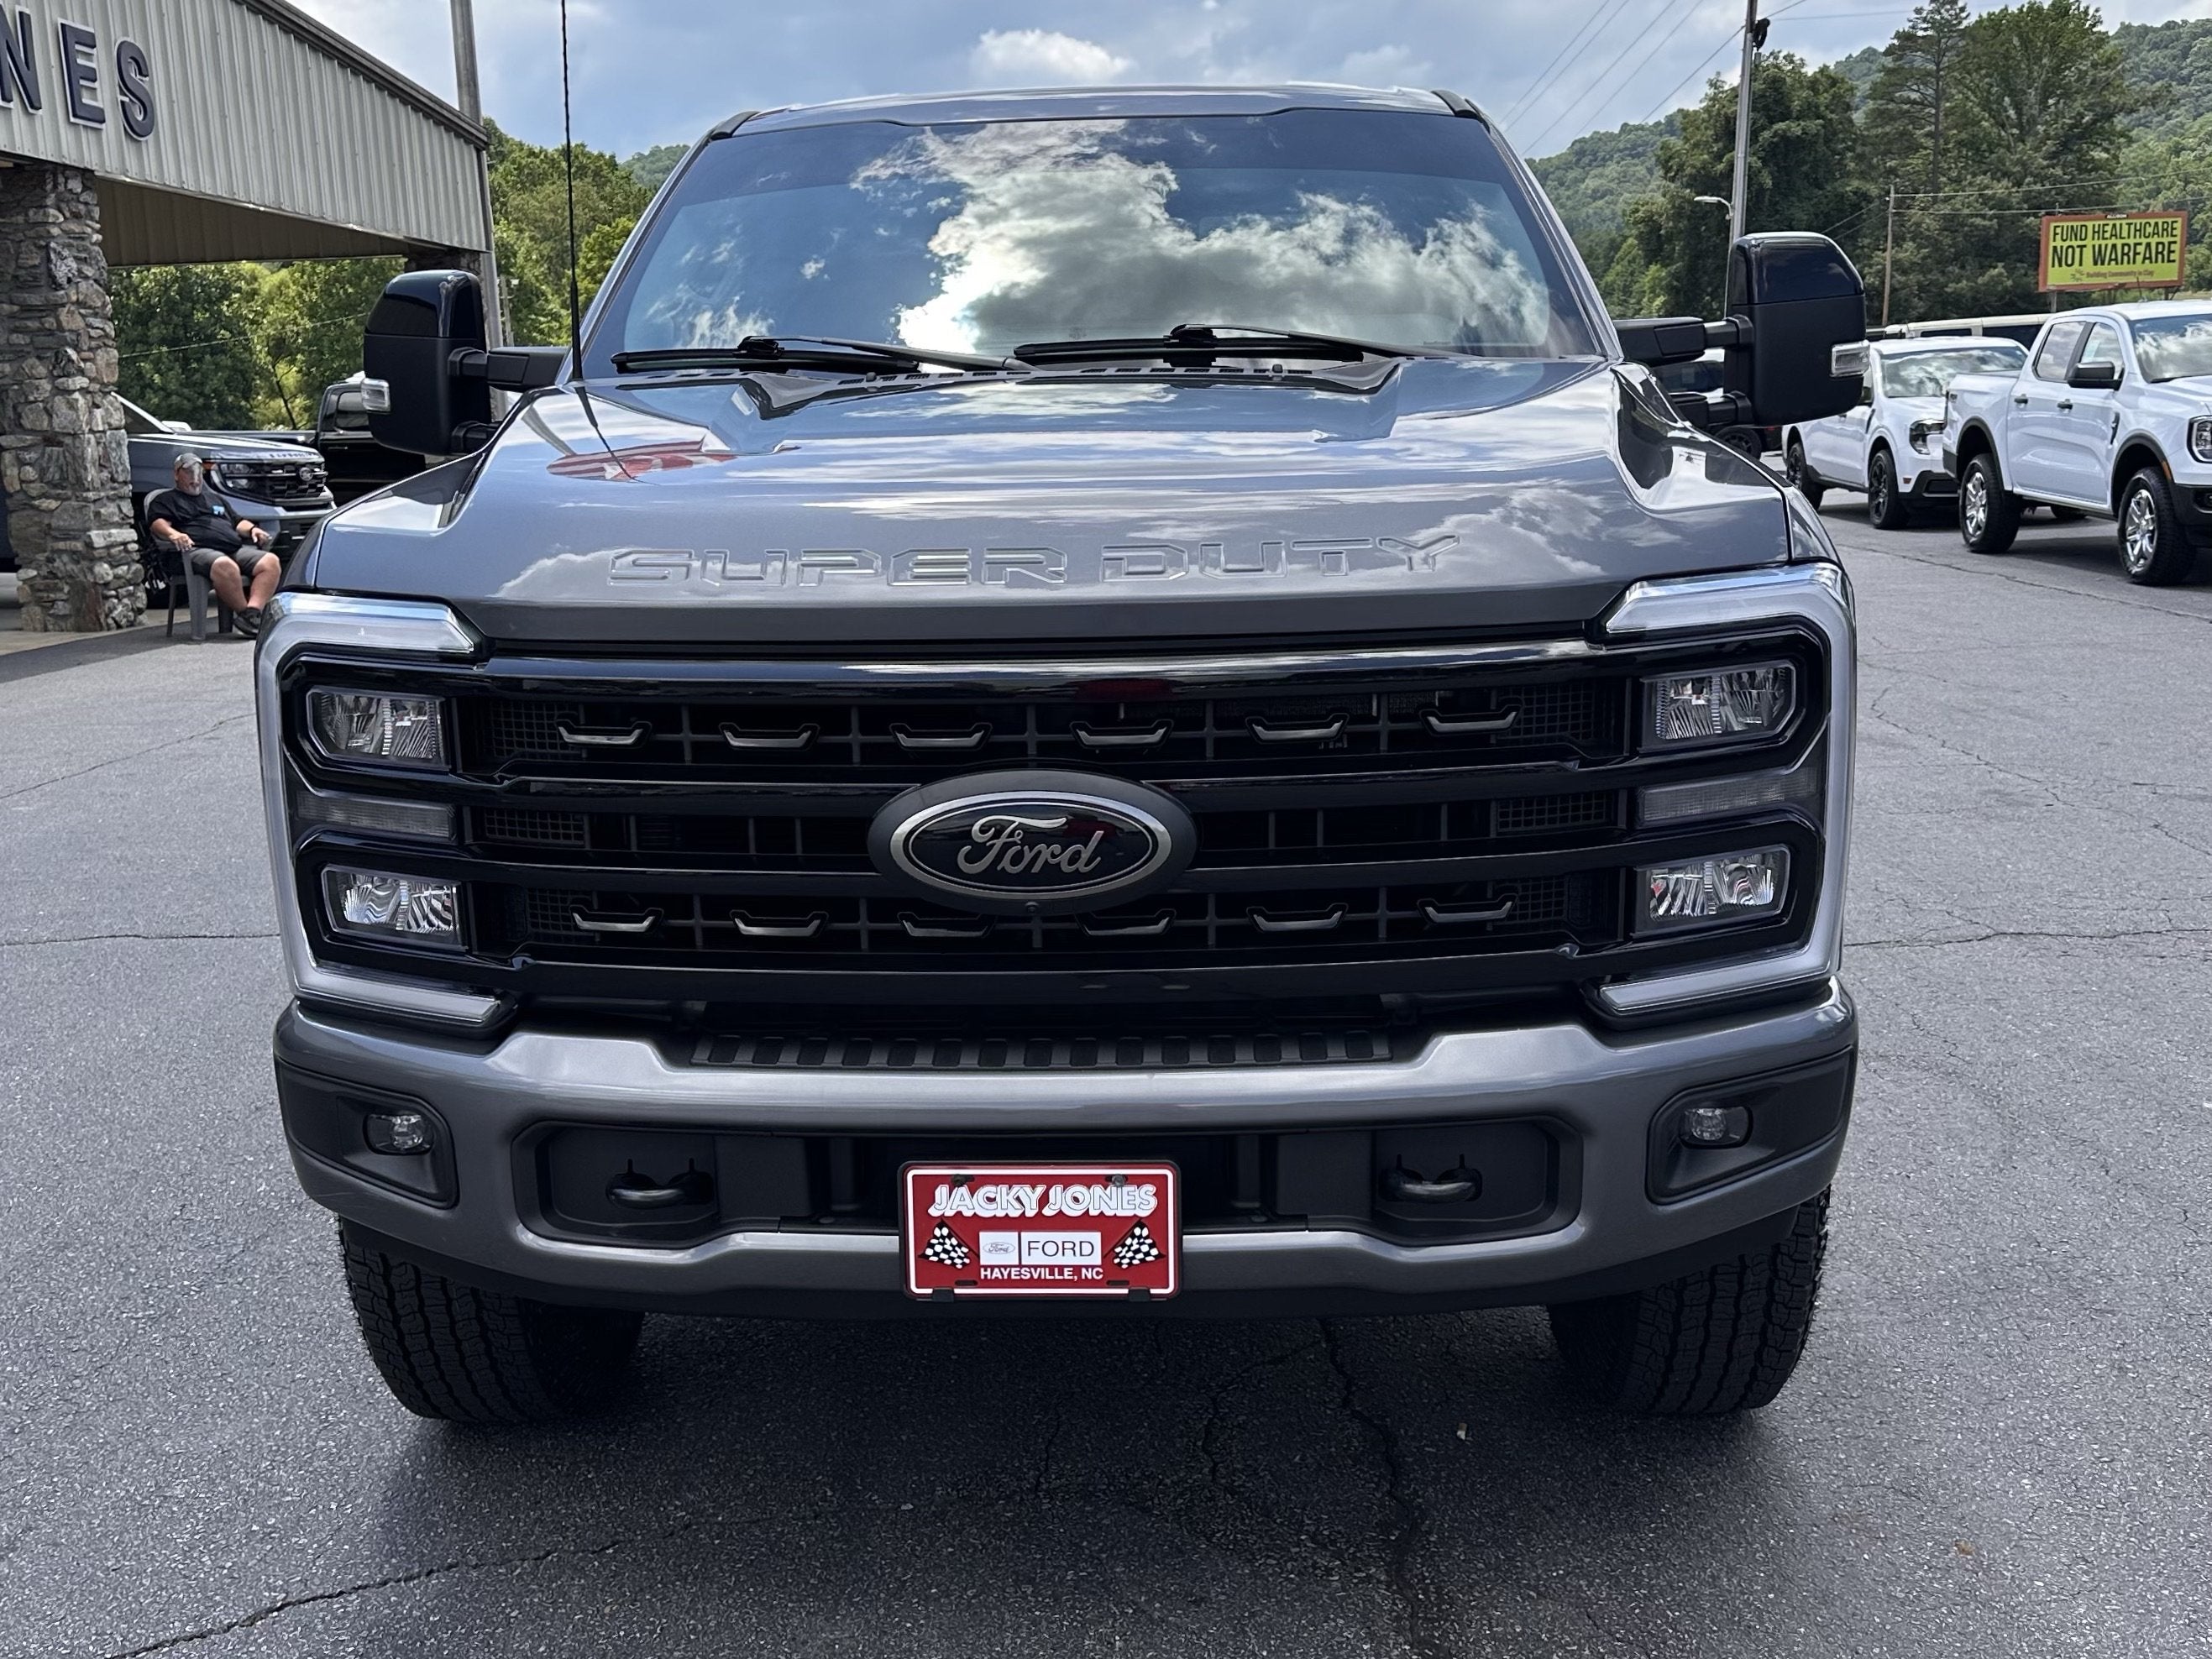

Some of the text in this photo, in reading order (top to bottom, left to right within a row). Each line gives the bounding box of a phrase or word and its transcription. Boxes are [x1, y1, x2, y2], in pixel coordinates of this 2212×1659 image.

[2052, 220, 2178, 243] FUND HEALTHCARE
[2052, 241, 2178, 268] NOT WARFARE
[609, 534, 1460, 587] SUPER DUTY
[957, 814, 1105, 875] Ford
[928, 1184, 1158, 1217] JACKY JONES
[1027, 1240, 1094, 1257] FORD
[980, 1268, 1103, 1281] HAYESVILLE, NC
